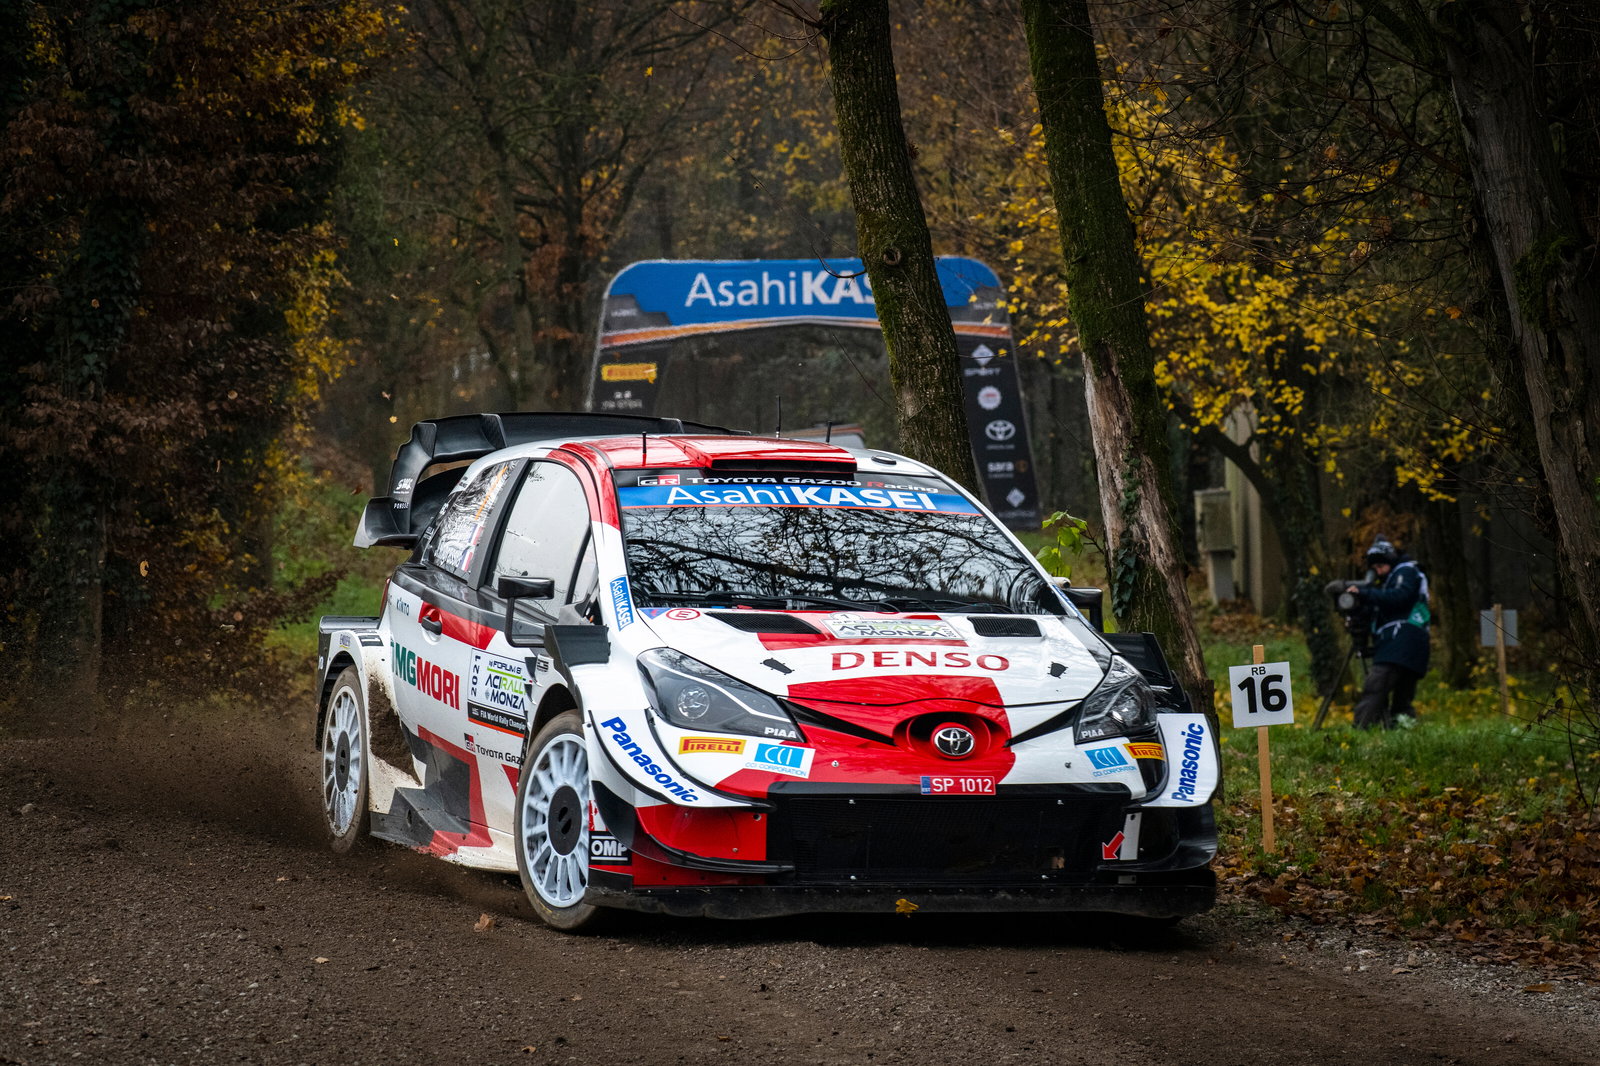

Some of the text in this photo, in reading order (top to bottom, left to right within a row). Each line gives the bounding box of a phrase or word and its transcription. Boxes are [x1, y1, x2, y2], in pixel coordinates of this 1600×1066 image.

[640, 478, 679, 486] GR
[686, 476, 939, 494] TOYOTA GAZOO Racing
[666, 485, 937, 511] AsahiKASEI
[611, 580, 632, 629] AsahiKASEI
[860, 630, 948, 638] MONZA
[831, 651, 1010, 671] DENSO
[471, 655, 481, 697] 2021
[1251, 666, 1266, 676] RB
[489, 689, 525, 711] MONZA
[1237, 674, 1287, 714] 16
[764, 726, 797, 739] PIAA
[1081, 728, 1105, 739] PIAA
[475, 744, 504, 760] TOYOTA
[682, 738, 742, 752] PIRELLI
[601, 716, 699, 803] Panasonic
[1171, 722, 1204, 803] Panasonic
[759, 763, 807, 777] CORPORATION
[932, 778, 993, 792] SP 1012
[591, 840, 628, 857] OMP
